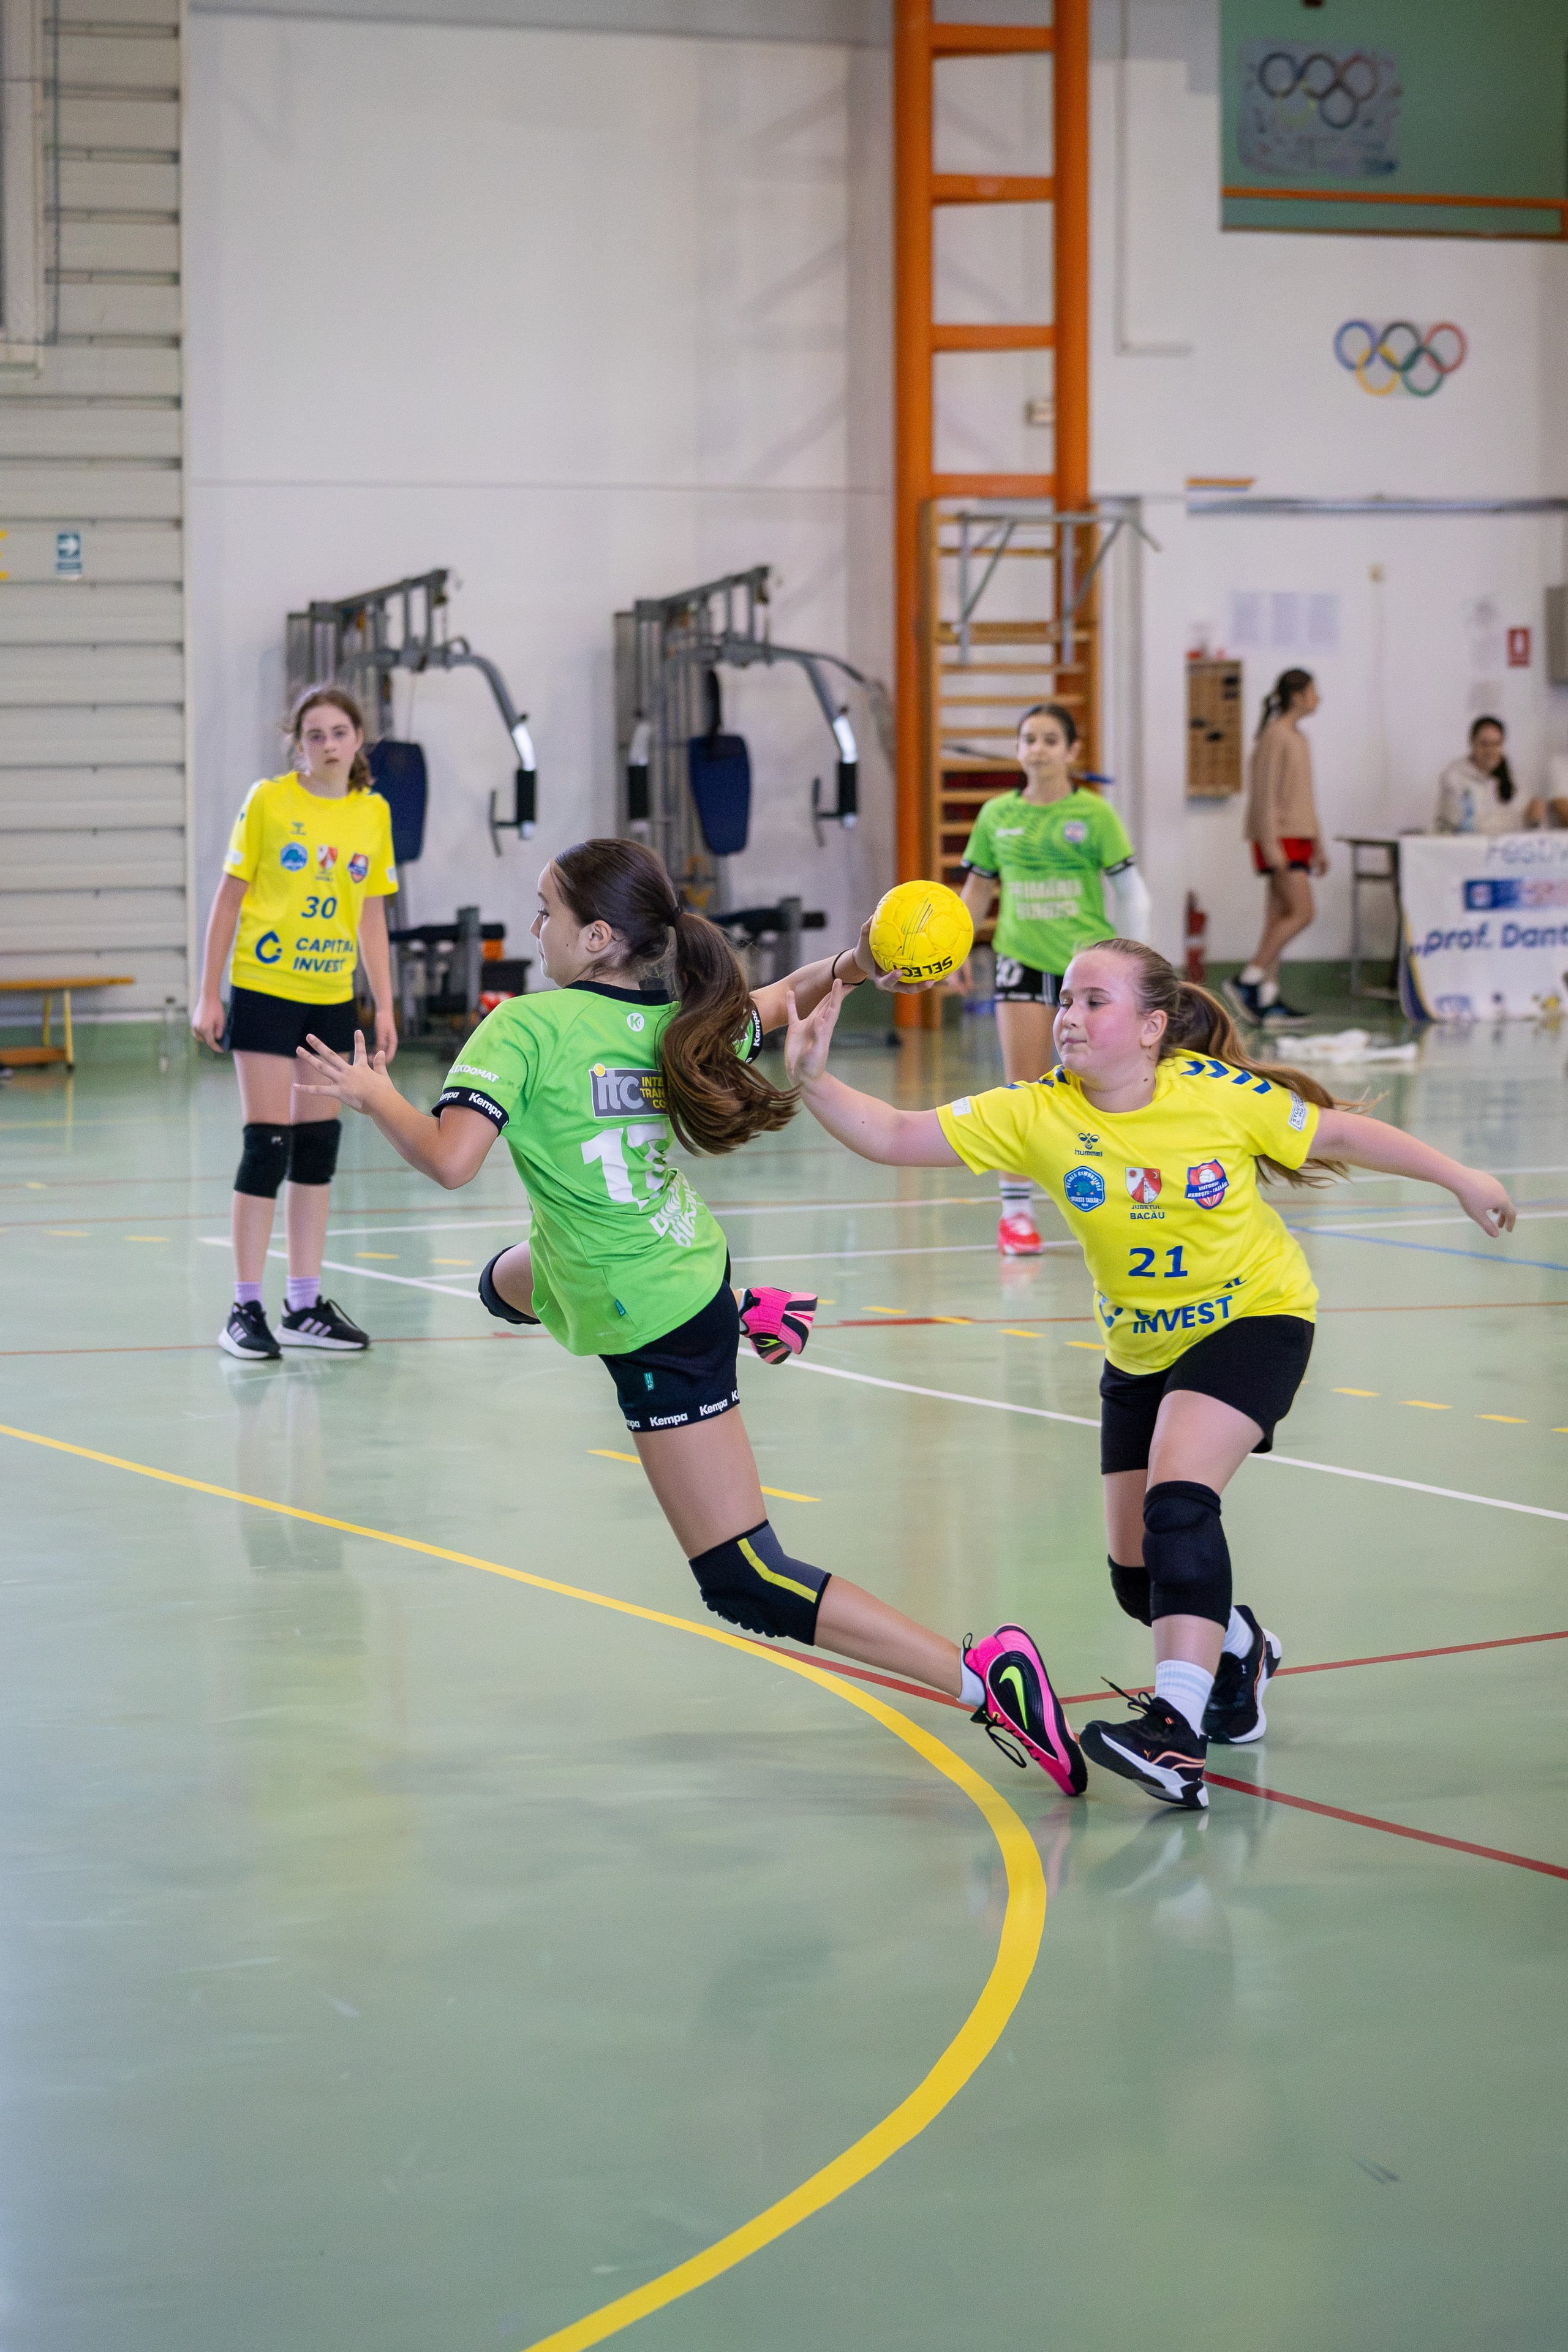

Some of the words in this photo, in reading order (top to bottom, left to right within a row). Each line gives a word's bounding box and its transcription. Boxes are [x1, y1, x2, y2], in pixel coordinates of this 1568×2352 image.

[300, 895, 337, 919] 30
[292, 957, 345, 973] INVEST
[893, 956, 953, 978] SELEC
[468, 1092, 503, 1119] Kempa
[1074, 1148, 1103, 1157] hummel
[1129, 1210, 1165, 1219] BACĂU
[1128, 1245, 1188, 1278] 21
[699, 1398, 728, 1416] Kempa
[649, 1412, 688, 1427] Kempa
